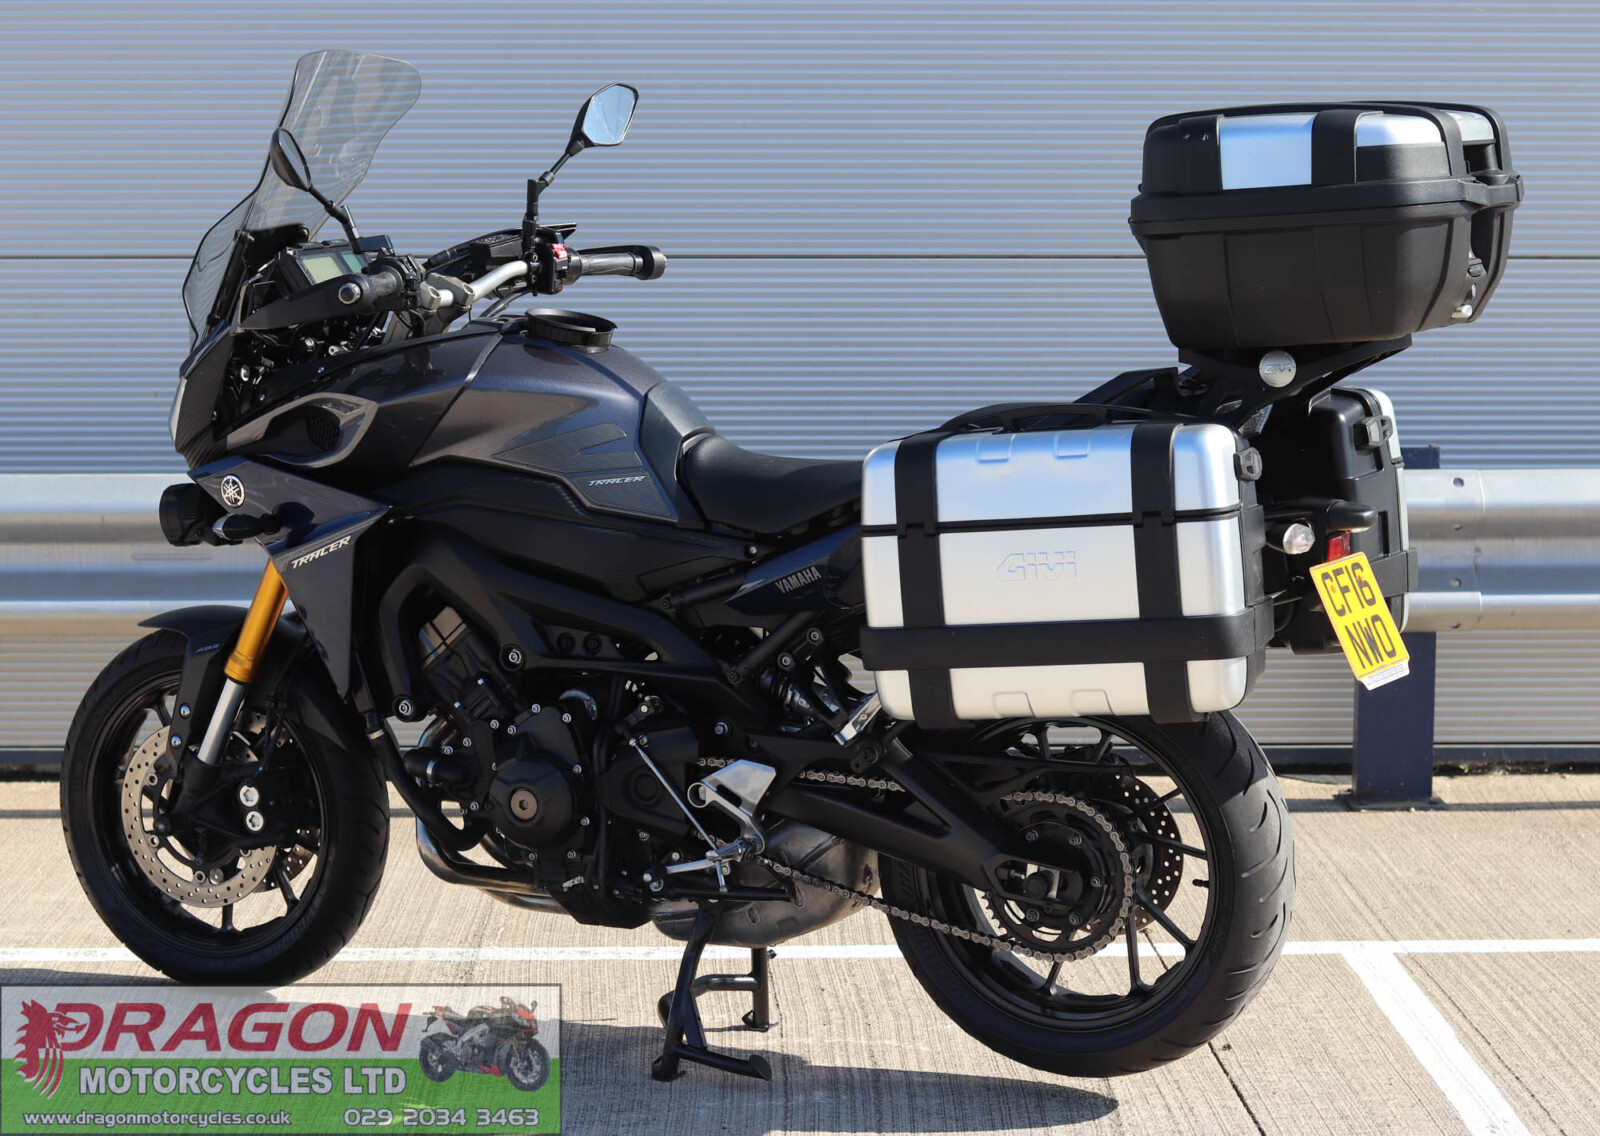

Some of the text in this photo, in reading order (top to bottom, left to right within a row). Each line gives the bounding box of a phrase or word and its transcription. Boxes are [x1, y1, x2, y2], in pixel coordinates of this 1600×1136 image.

[588, 475, 646, 487] TRACER
[291, 535, 351, 569] TRACER
[996, 550, 1077, 581] GIVI
[775, 566, 822, 594] YAMAHA
[1321, 561, 1377, 618] CF16
[1344, 614, 1397, 670] NWO
